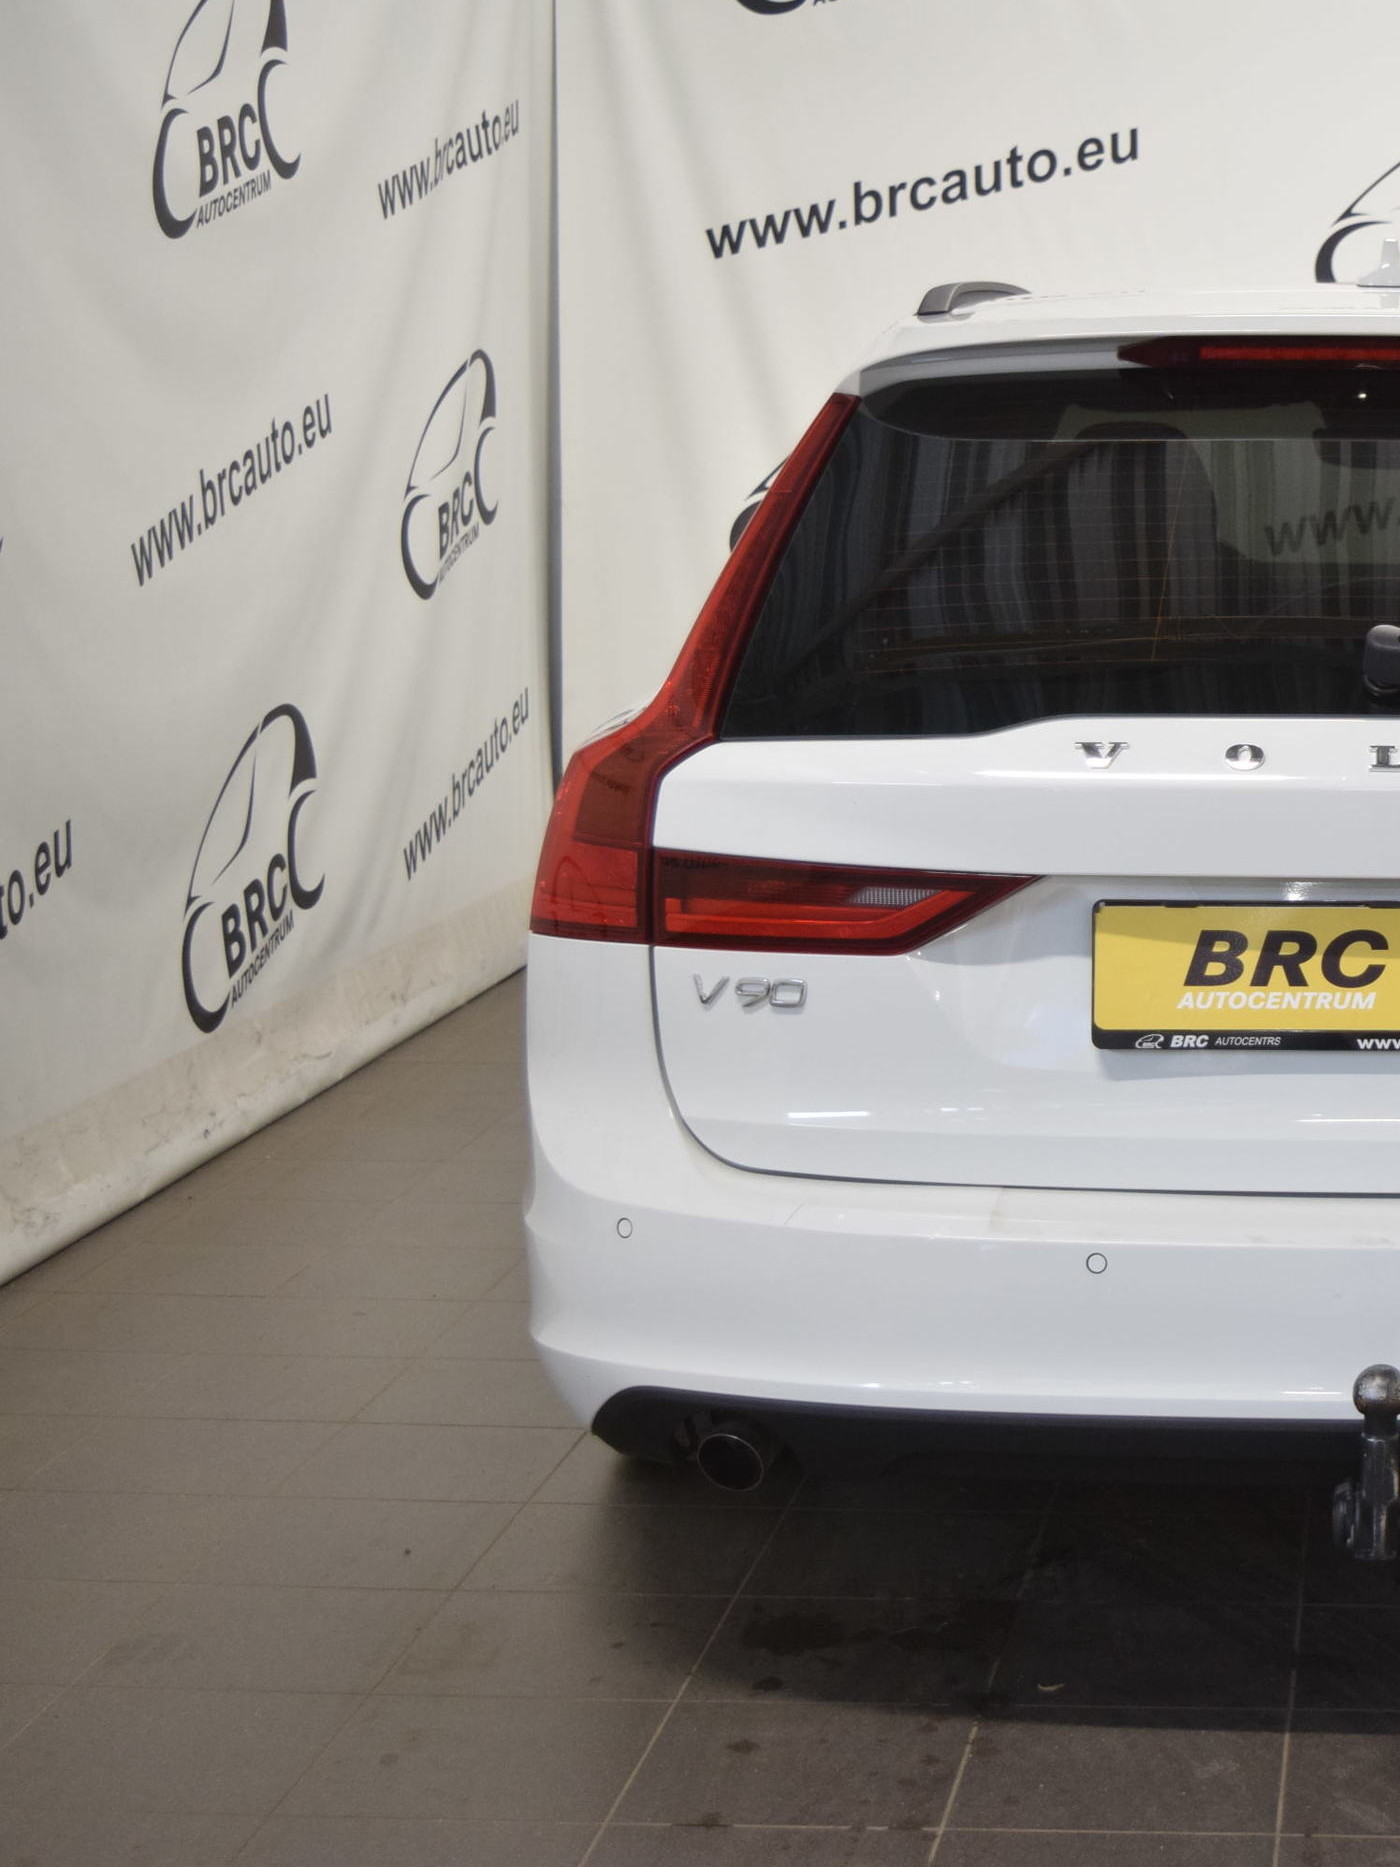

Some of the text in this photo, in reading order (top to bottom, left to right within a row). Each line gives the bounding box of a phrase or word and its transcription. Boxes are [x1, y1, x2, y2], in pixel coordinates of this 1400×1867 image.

[197, 103, 261, 198] BRC
[378, 100, 519, 220] www.brcauto.eu
[705, 128, 1139, 260] www.brcauto.eu
[196, 170, 272, 228] AUTOCENTRUM
[131, 393, 332, 588] www.brcauto.eu
[438, 470, 474, 561] BRC
[403, 687, 530, 882] www.brcauto.eu
[221, 853, 288, 979] BRC
[231, 909, 295, 1009] AUTOCENTRUM
[1183, 929, 1390, 989] BRC
[694, 973, 808, 1009] V90
[1176, 991, 1376, 1010] AUTOCENTRUM
[1170, 1034, 1209, 1048] BRC
[1214, 1036, 1282, 1046] AUTOCENTRS
